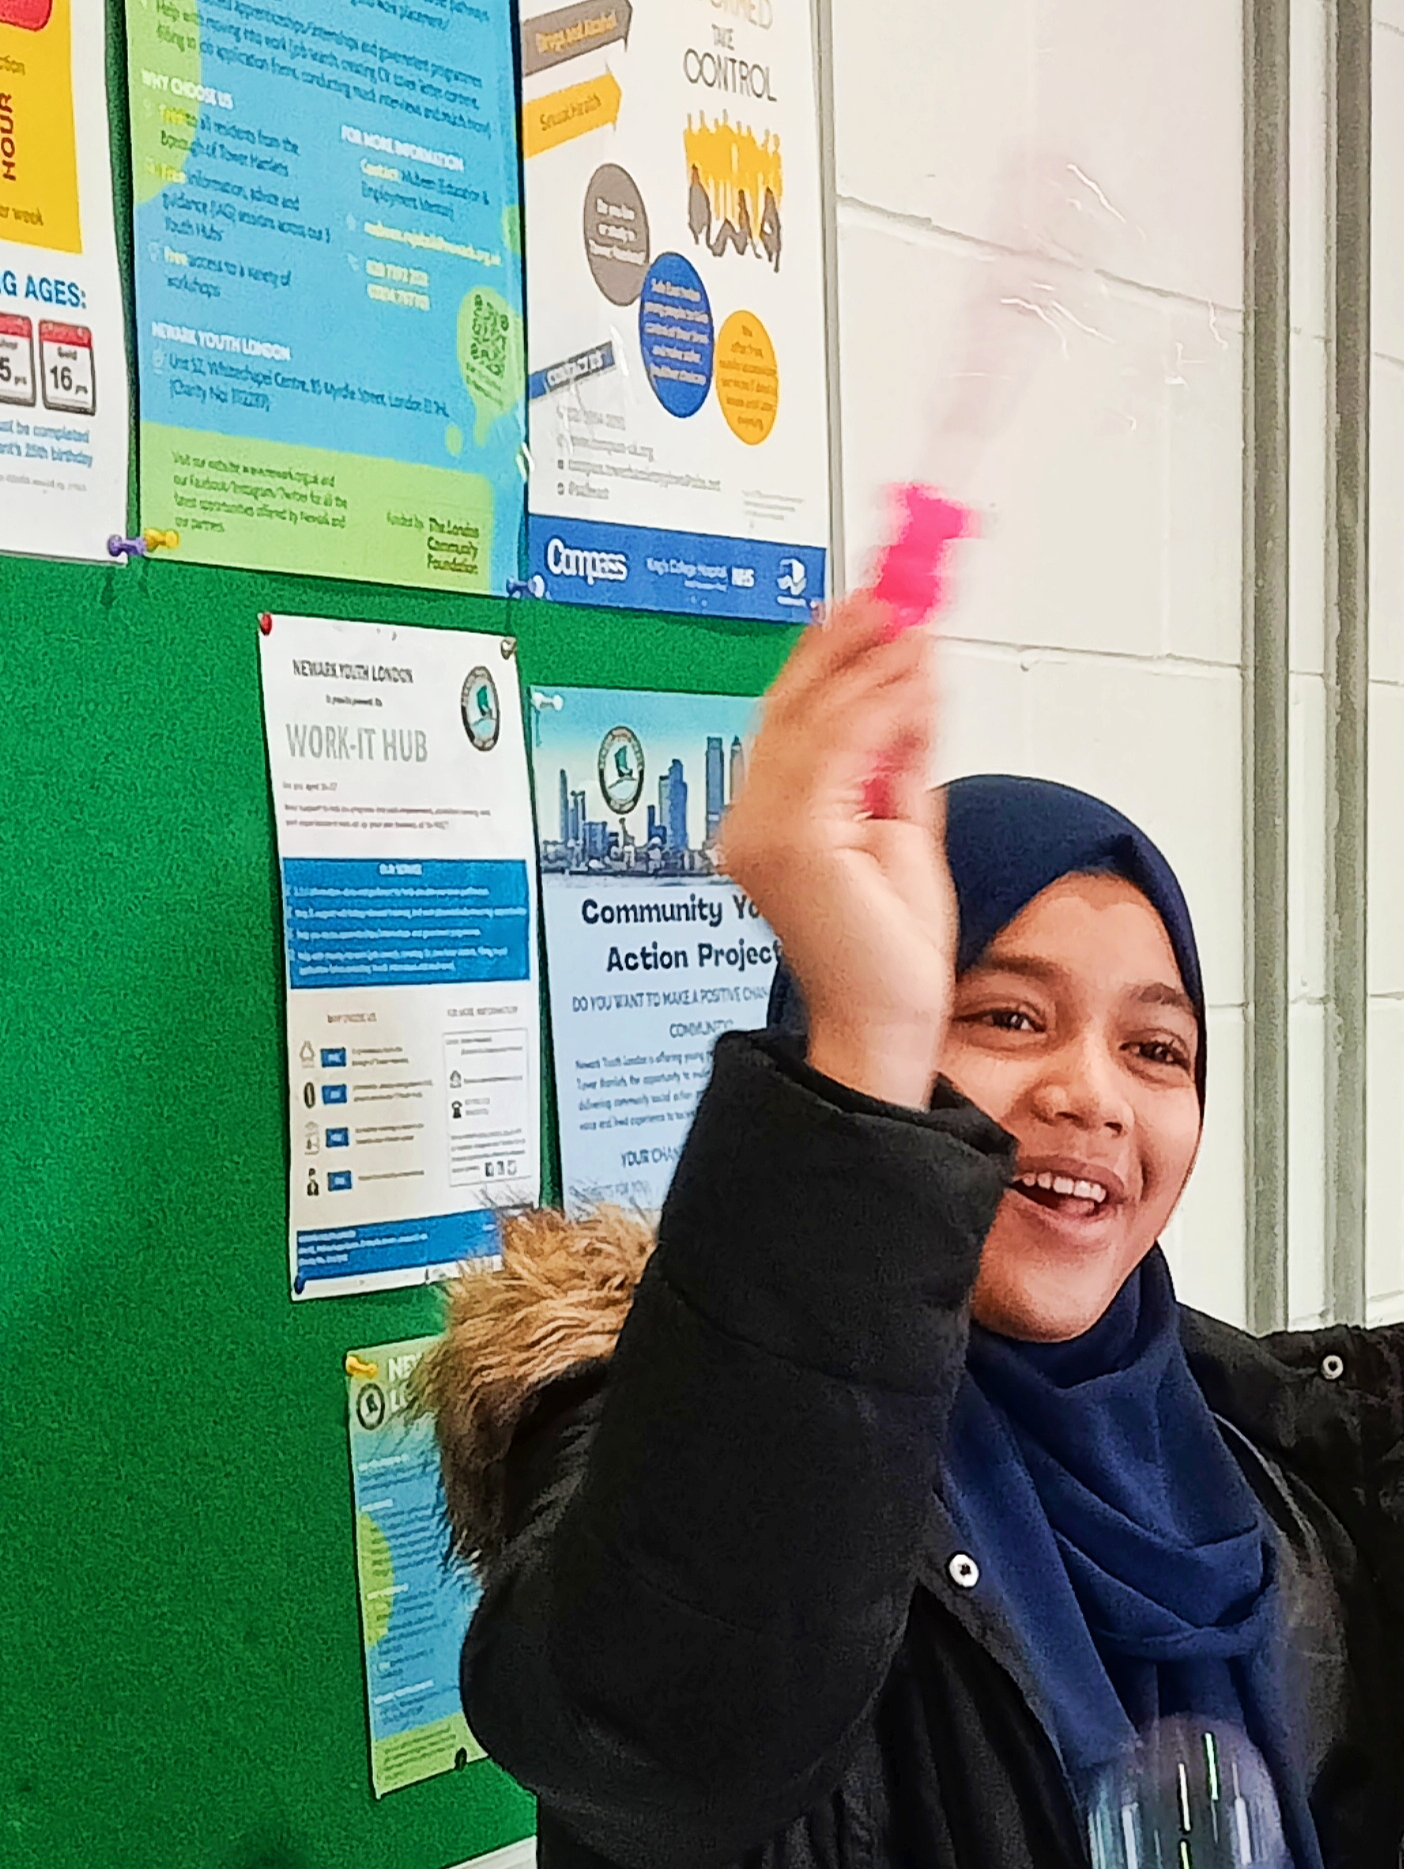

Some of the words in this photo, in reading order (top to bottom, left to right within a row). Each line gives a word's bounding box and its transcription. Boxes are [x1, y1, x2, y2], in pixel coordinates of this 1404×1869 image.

[141, 67, 169, 91] WHY
[171, 77, 217, 106] CHOOSE
[218, 90, 234, 110] US
[683, 47, 777, 101] CONTROL
[25, 273, 87, 310] AGES:
[152, 321, 198, 347] NEWARK
[198, 330, 241, 354] YOUTH
[242, 337, 292, 363] LONDON
[0, 356, 12, 382] 5
[50, 365, 73, 391] 16
[547, 538, 628, 585] Compass
[293, 659, 338, 679] NEWARK
[339, 662, 369, 681] YOUTH
[372, 665, 414, 684] LONDON
[285, 723, 377, 761] WORK-IT
[382, 728, 429, 762] HUB
[582, 892, 723, 928] Community
[607, 941, 689, 973] Action
[698, 938, 783, 973] Project
[572, 995, 589, 1012] DO
[590, 995, 613, 1013] YOU
[614, 992, 645, 1010] WANT
[646, 993, 661, 1008] TO
[662, 990, 691, 1007] MAKE
[692, 989, 699, 1004] A
[700, 986, 741, 1004] POSITIVE
[621, 1149, 649, 1168] YOUR
